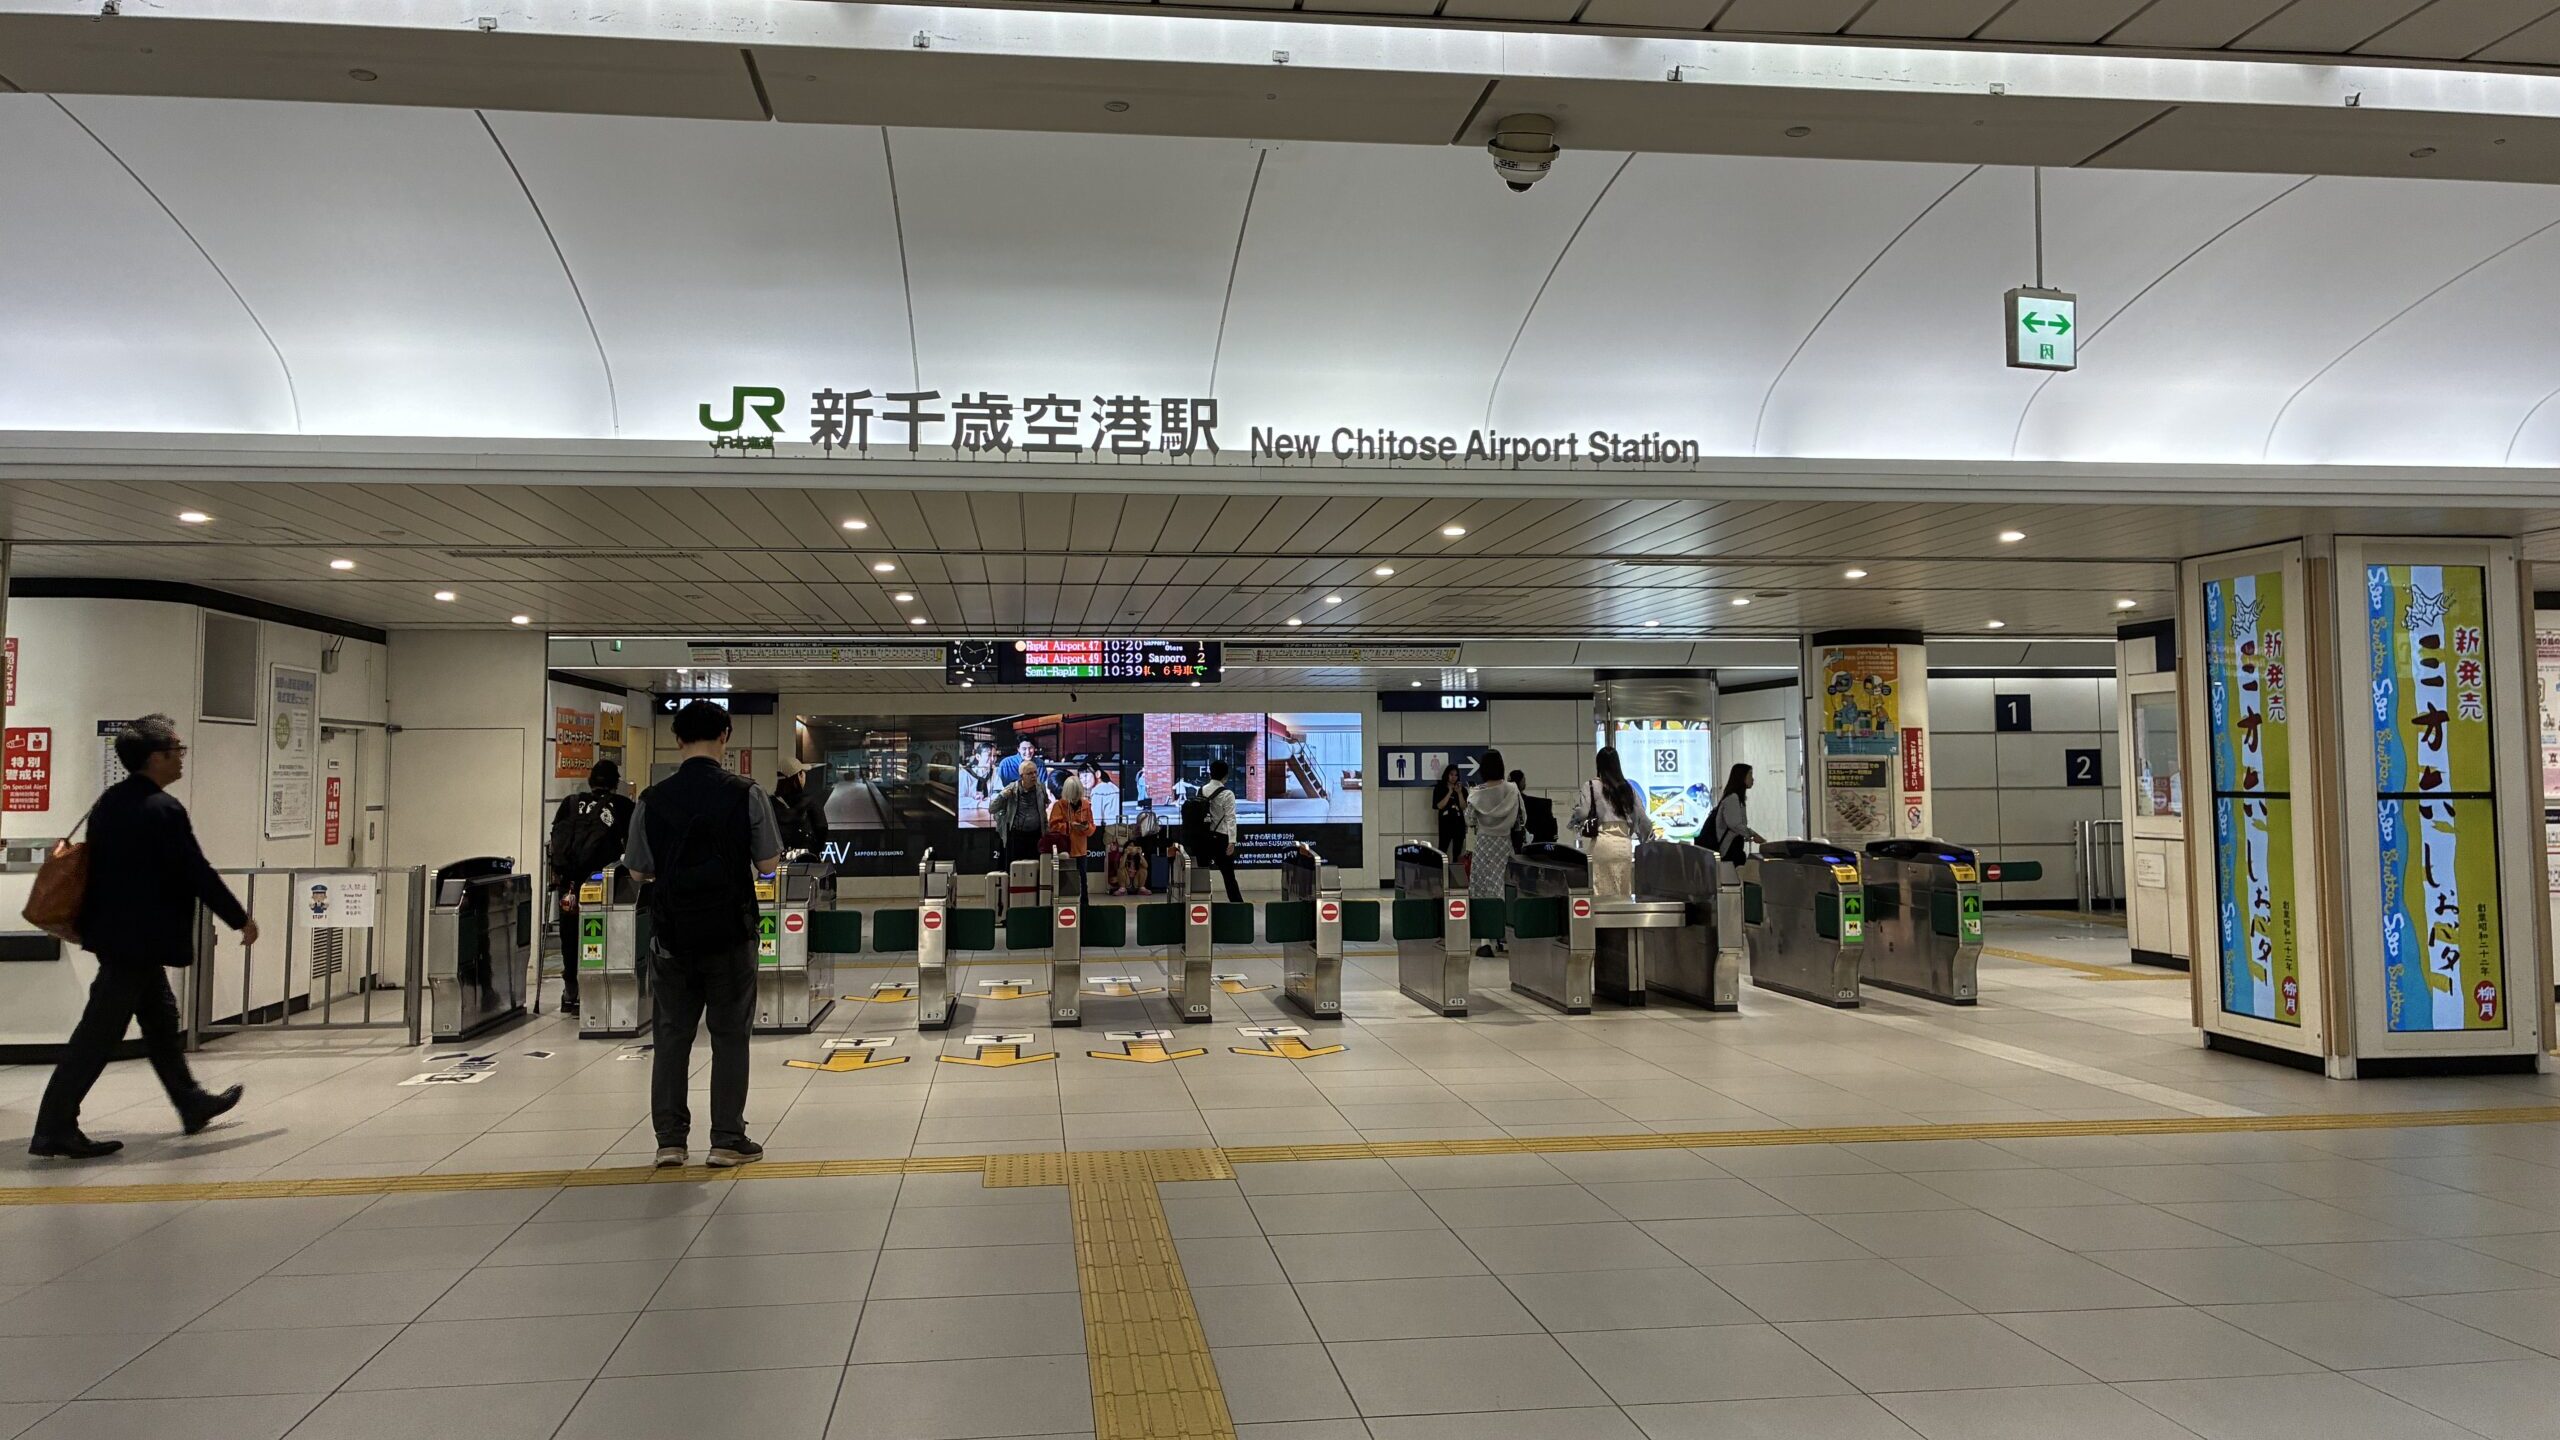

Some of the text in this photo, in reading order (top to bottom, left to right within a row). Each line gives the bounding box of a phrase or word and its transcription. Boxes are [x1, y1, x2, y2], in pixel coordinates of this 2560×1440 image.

[699, 386, 785, 433] JR
[810, 388, 1220, 457] 新千歳空港駅
[1251, 427, 1699, 468] New Chitose Airport Station
[1026, 641, 1048, 652] Rapid
[1053, 641, 1087, 652] Airport
[1088, 641, 1099, 651] 47
[1104, 641, 1143, 651] 10:20
[1198, 641, 1205, 651] 1
[1026, 653, 1206, 664] Rapid Airport 49 10:29 Sapporo 2
[1025, 666, 1143, 677] Semi-Rapid 51 10:39
[2264, 631, 2286, 721] 新発売
[2454, 626, 2484, 721] 新発売
[2008, 701, 2017, 724] 1
[11, 756, 40, 768] 特別
[1658, 750, 1676, 760] KO
[1658, 760, 1676, 771] KO
[6, 769, 46, 780] 警戒中
[2076, 756, 2092, 779] 2
[2477, 903, 2490, 976] 創業昭和二十二年
[2476, 986, 2496, 1017] 柳月
